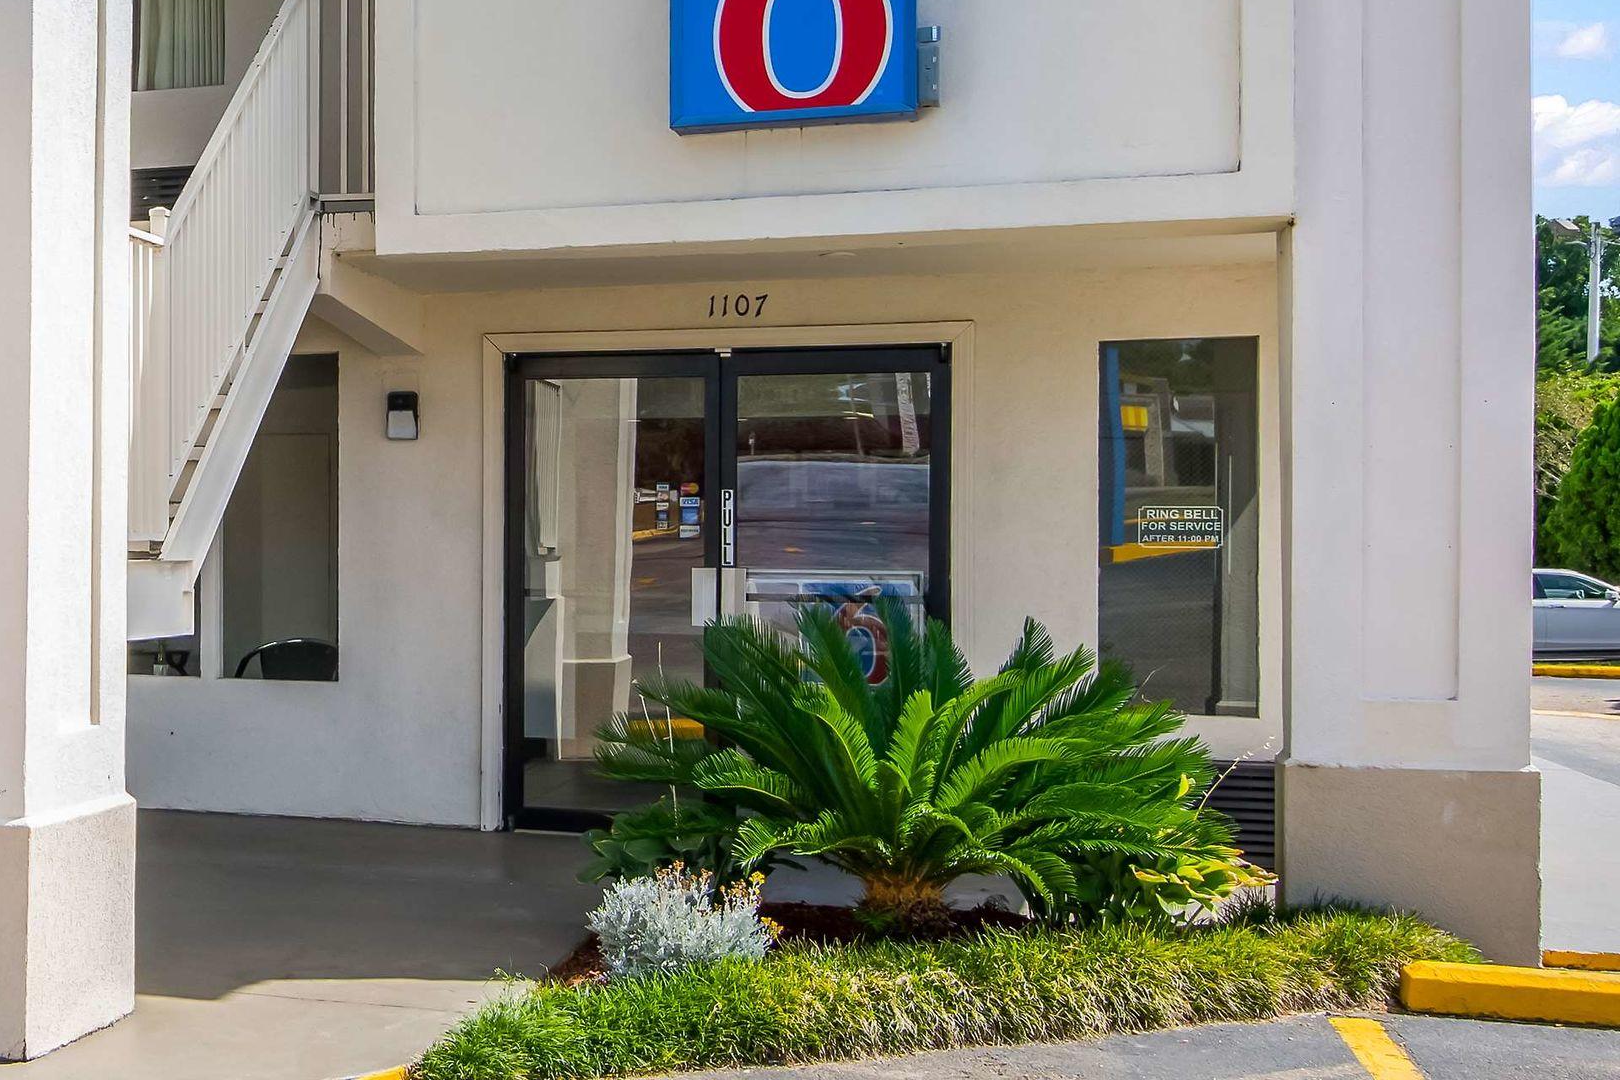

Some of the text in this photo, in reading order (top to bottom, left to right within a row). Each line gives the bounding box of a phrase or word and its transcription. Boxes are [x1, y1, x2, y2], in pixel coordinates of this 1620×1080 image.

[708, 293, 769, 318] 1107
[1146, 509, 1219, 520] RING BELL
[722, 490, 732, 565] PULL
[1141, 521, 1221, 531] FOR SERVICE
[1142, 534, 1219, 543] AFTER 11:00 PM
